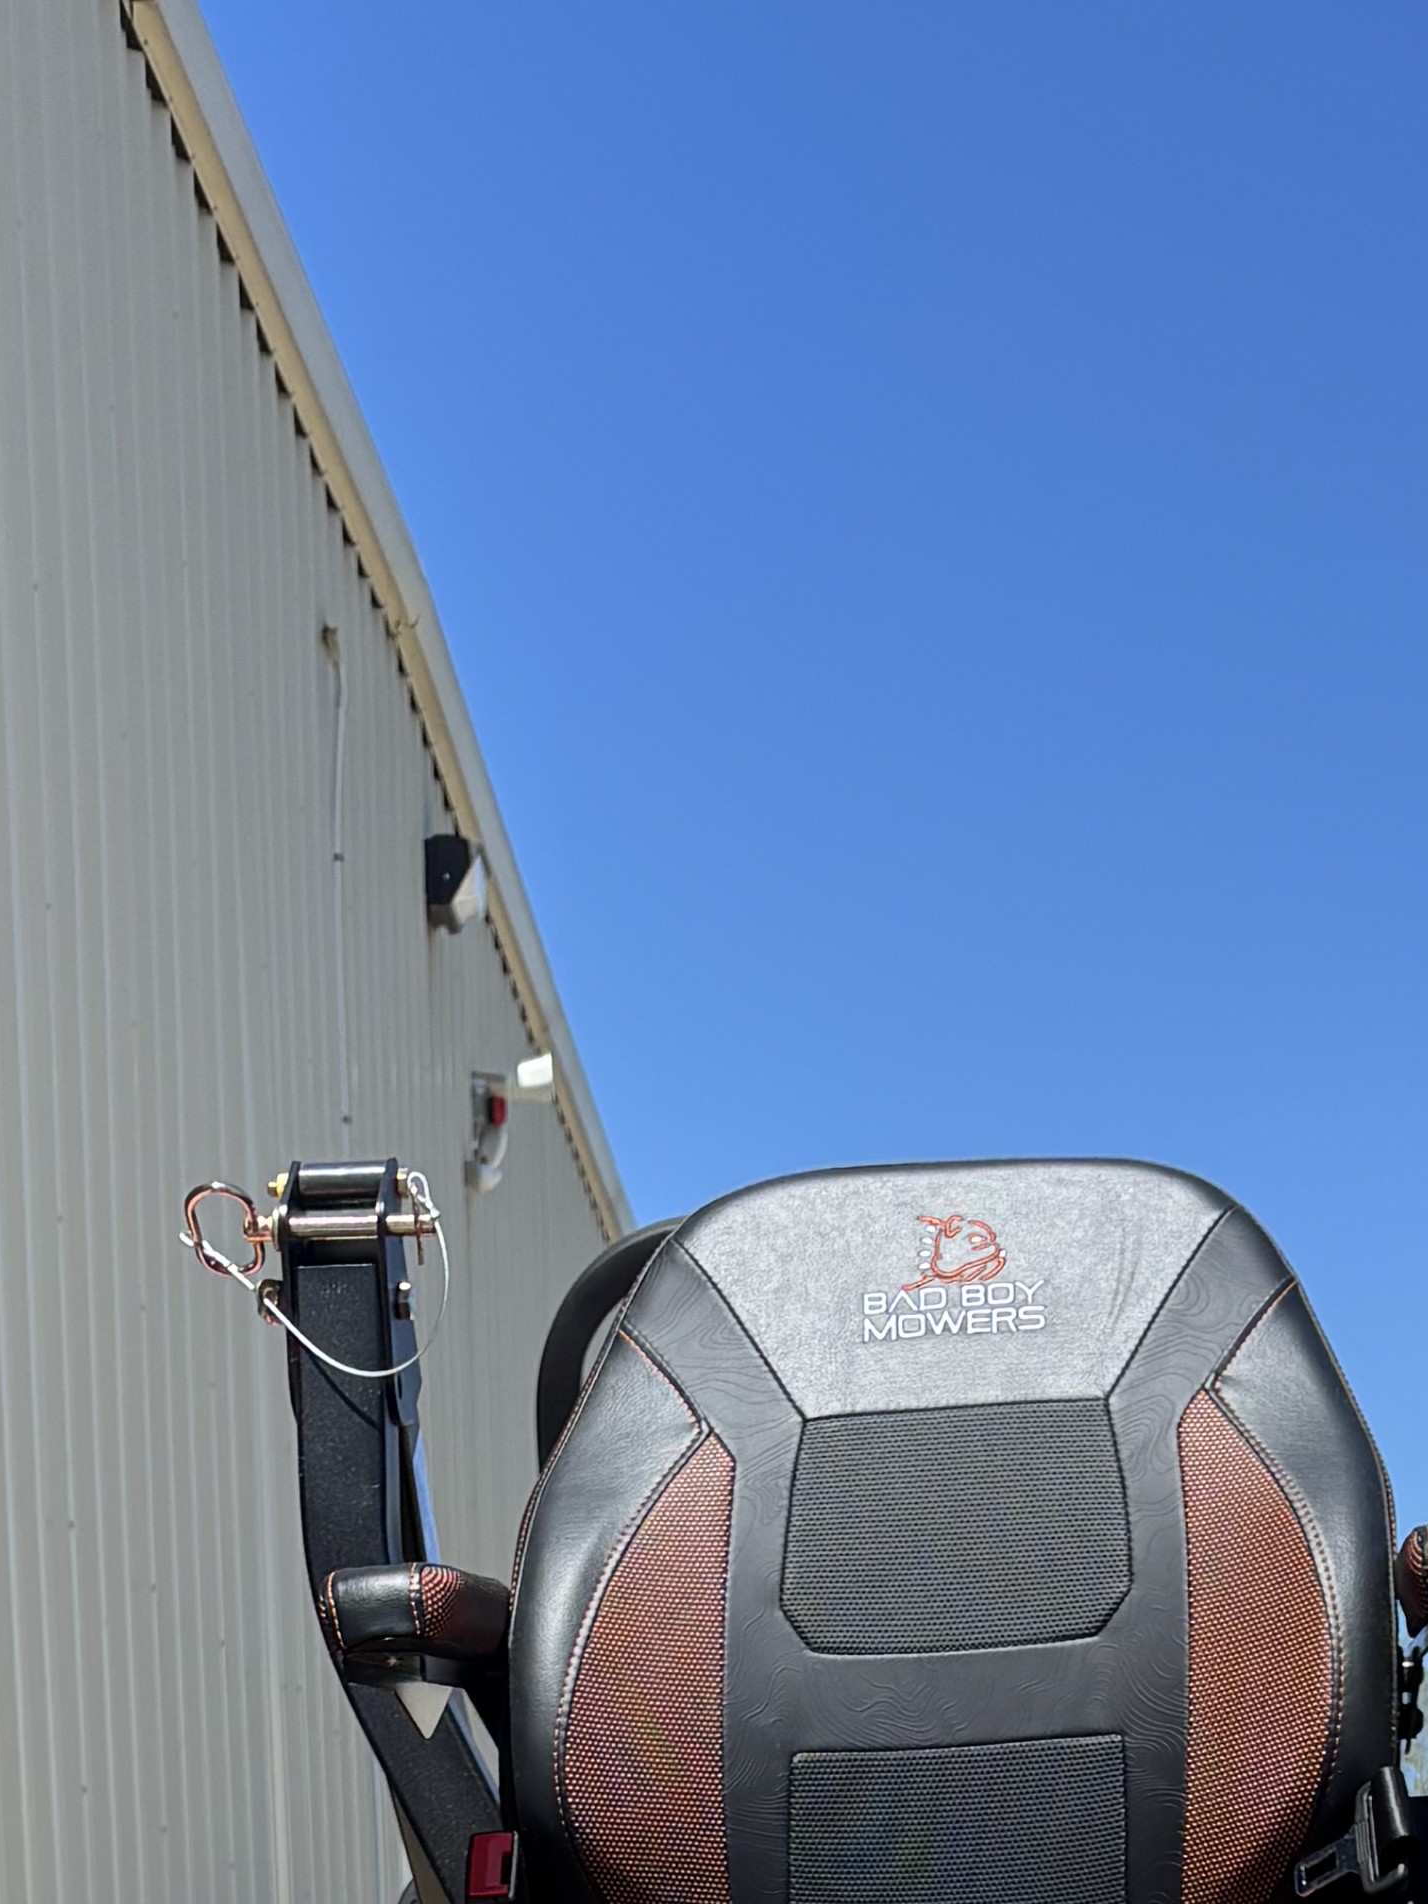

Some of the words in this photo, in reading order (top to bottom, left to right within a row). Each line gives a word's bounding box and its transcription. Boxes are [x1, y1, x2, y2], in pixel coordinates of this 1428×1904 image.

[862, 1286, 948, 1316] BAD
[960, 1279, 1045, 1308] BOY
[862, 1305, 1047, 1342] MOWERS
